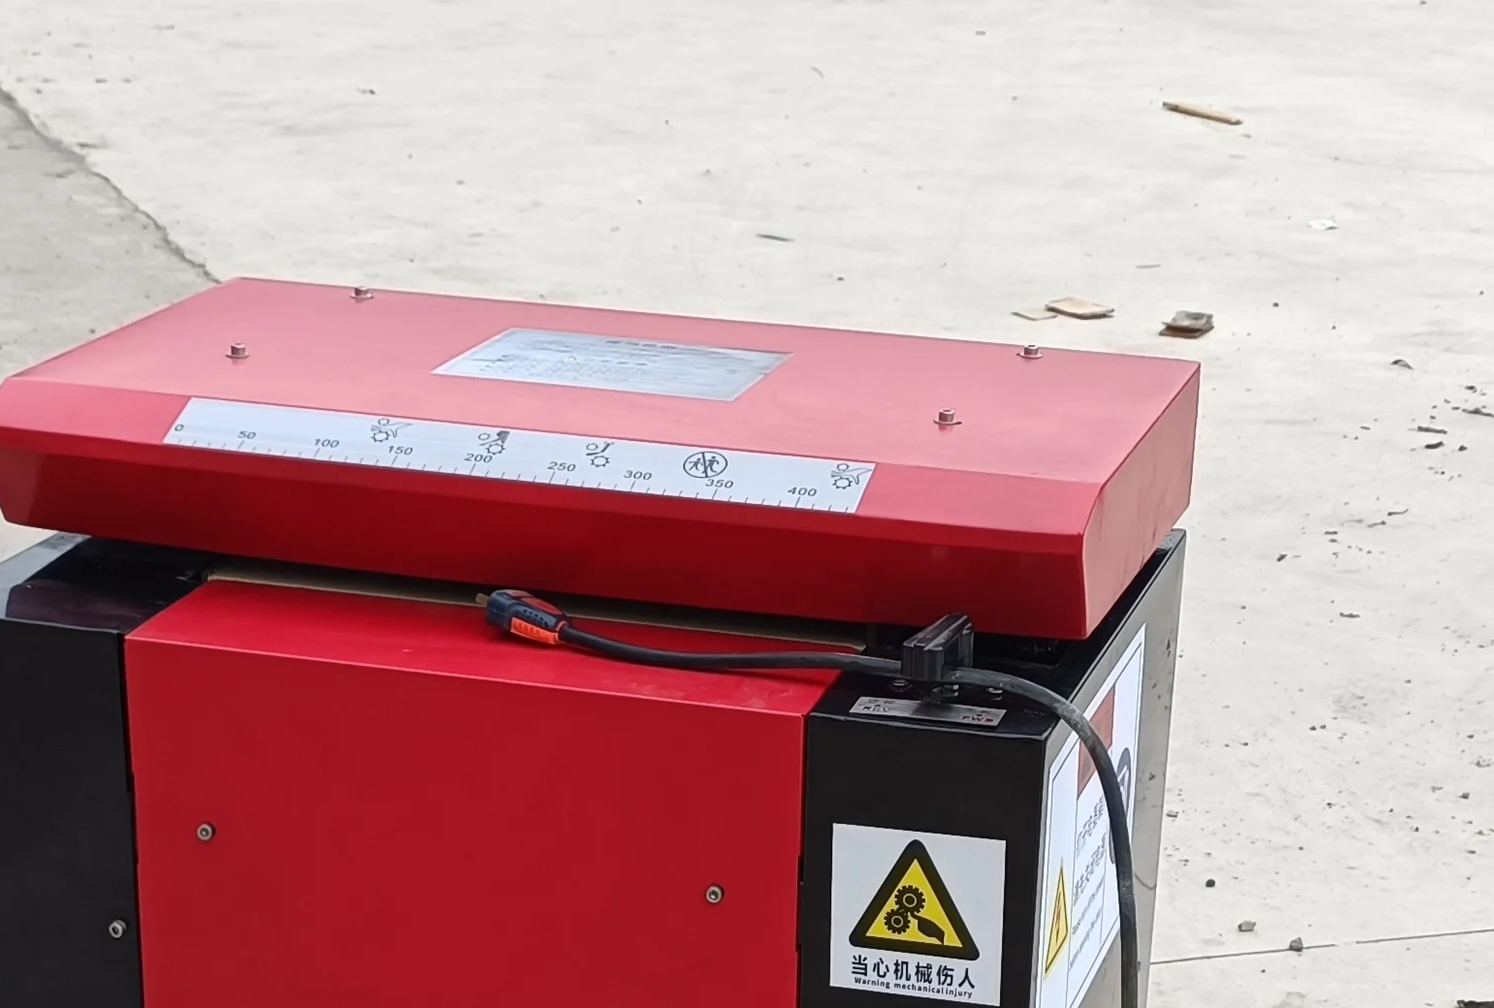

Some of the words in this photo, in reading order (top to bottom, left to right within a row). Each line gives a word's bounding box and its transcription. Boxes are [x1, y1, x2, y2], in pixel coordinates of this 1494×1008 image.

[237, 430, 257, 440] 50
[314, 437, 341, 449] 100
[387, 445, 414, 456] 150
[463, 452, 494, 464] 200
[547, 460, 577, 473] 250
[623, 469, 653, 481] 300
[705, 477, 735, 489] 350
[787, 485, 818, 498] 400
[851, 954, 975, 989] 当心机械伤人
[854, 976, 891, 989] Warning
[893, 982, 944, 995] mechanical
[945, 987, 973, 999] injury
